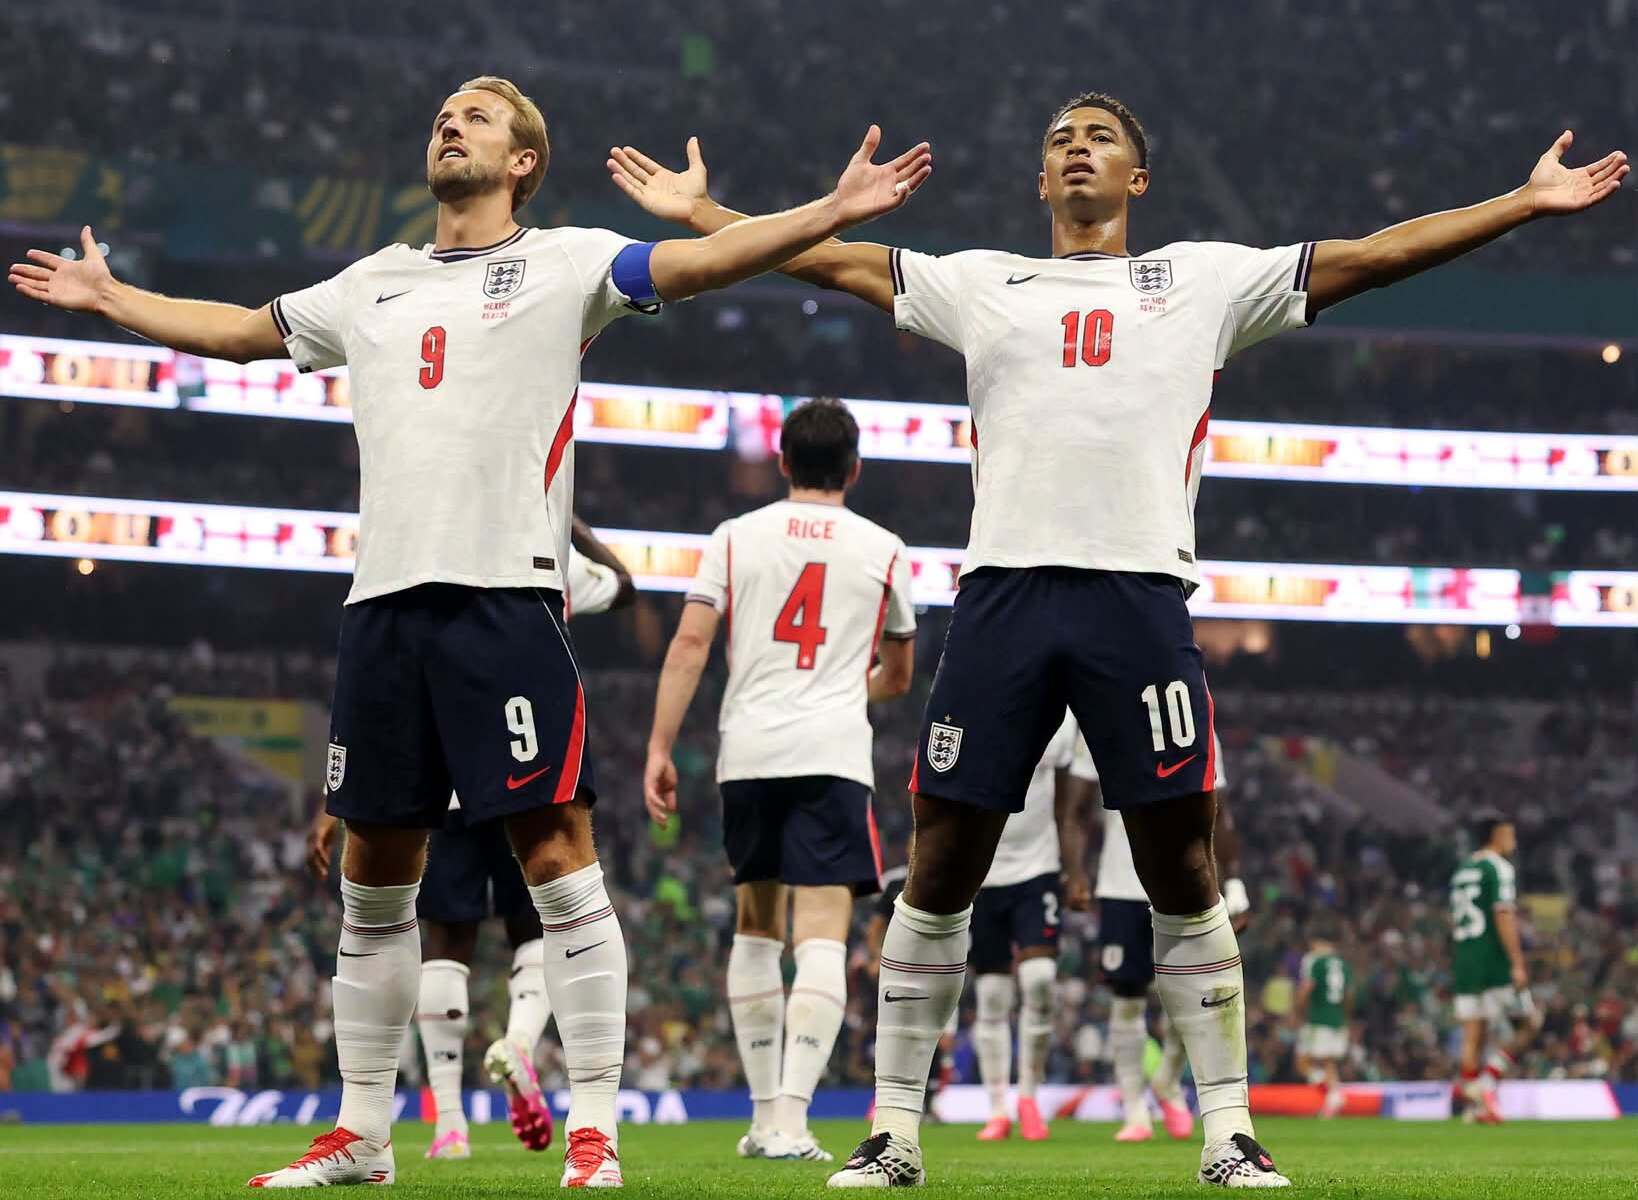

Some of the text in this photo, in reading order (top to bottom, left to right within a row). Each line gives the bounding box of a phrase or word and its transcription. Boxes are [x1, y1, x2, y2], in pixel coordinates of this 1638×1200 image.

[419, 326, 446, 389] 9
[1061, 309, 1114, 368] 10
[787, 518, 836, 540] RICE
[773, 562, 827, 669] 4
[504, 695, 539, 762] 9
[1141, 680, 1196, 751] 10
